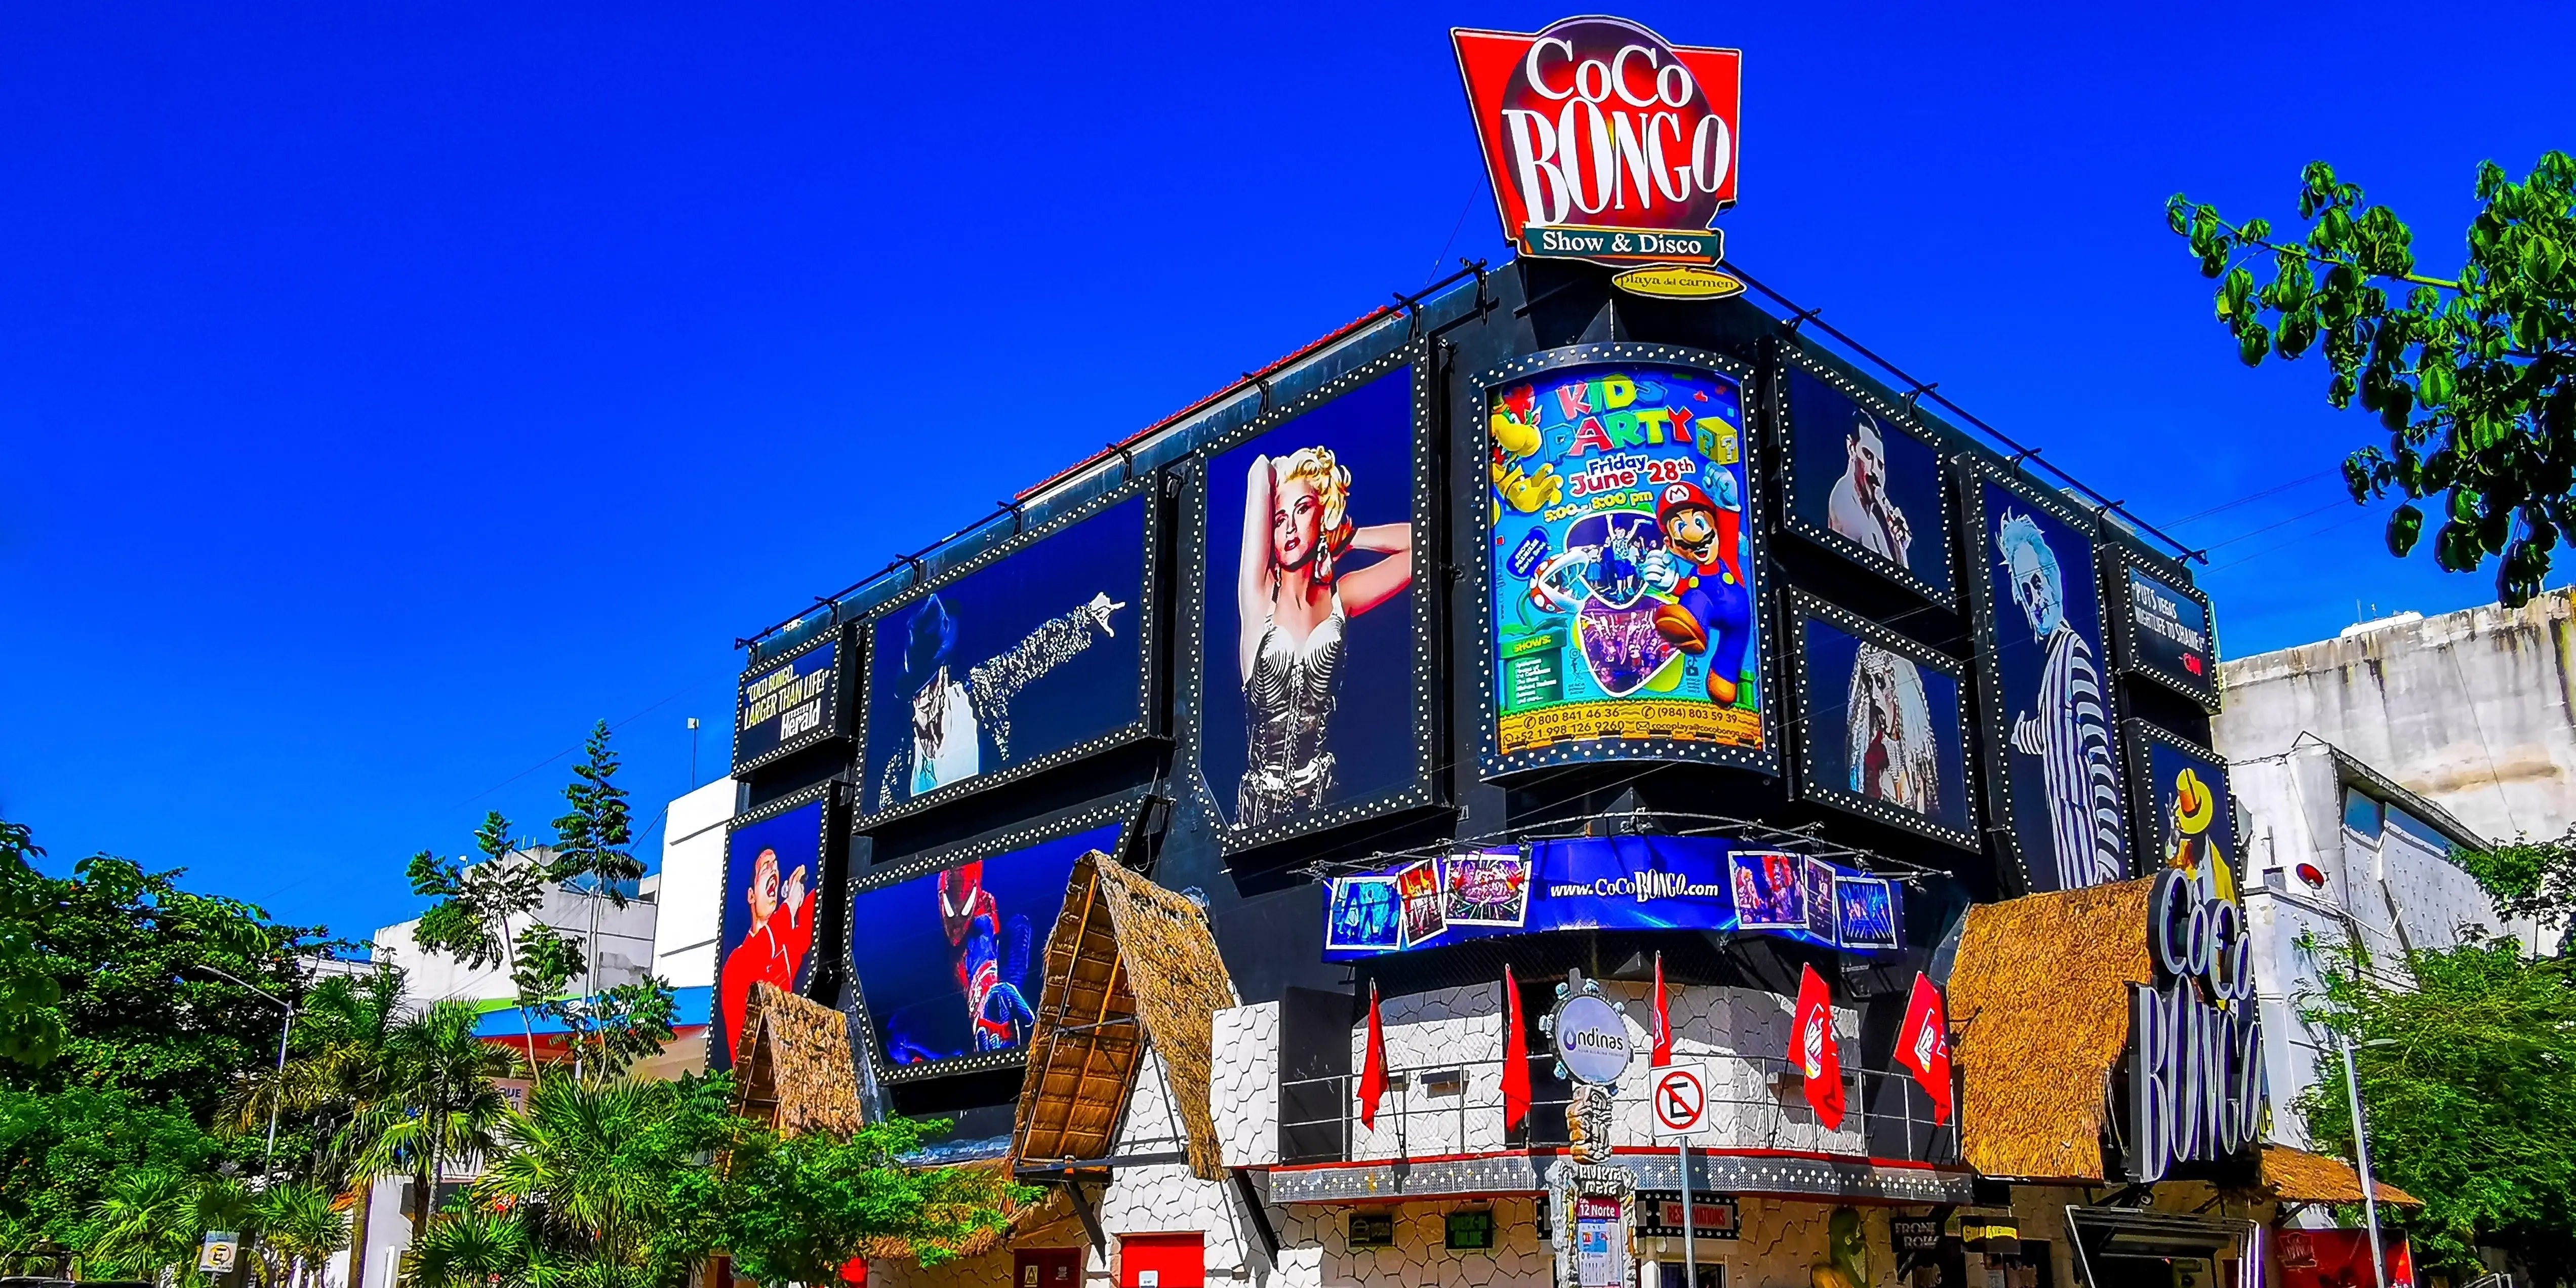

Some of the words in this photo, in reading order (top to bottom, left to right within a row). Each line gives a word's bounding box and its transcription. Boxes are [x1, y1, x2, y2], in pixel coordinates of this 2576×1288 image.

[1501, 95, 1730, 228] BONGO
[1543, 231, 1604, 252] Show
[1611, 233, 1632, 253] &
[1639, 234, 1702, 254] Disco
[1621, 274, 1661, 288] playa
[1679, 278, 1734, 288] carmen
[1557, 373, 1668, 420] KIDS
[1543, 407, 1695, 462] PARTY
[1589, 455, 1646, 475] Friday
[1571, 471, 1635, 495] June
[1647, 459, 1694, 482] 28th
[1544, 503, 1577, 522] 5:00
[1591, 492, 1626, 510] 8:00
[1630, 491, 1653, 506] pm
[744, 693, 778, 731] LARGER
[778, 678, 803, 712] THAN
[1658, 707, 1686, 719] (984)
[1688, 709, 1708, 719] 803
[1711, 711, 1723, 721] 59
[1725, 713, 1738, 723] 39
[780, 698, 821, 742] Herald
[1538, 713, 1559, 726] 800
[1562, 711, 1582, 721] 841
[1586, 708, 1601, 718] 46
[1604, 707, 1620, 717] 36
[1514, 730, 1534, 742] +52
[1537, 729, 1543, 738] 1
[1546, 725, 1567, 736] 998
[1571, 722, 1591, 733] 126
[1594, 720, 1625, 731] 9260
[2139, 972, 2261, 1183] BONGO
[1579, 1204, 1590, 1216] 12
[1591, 1204, 1616, 1217] Norte
[1667, 1204, 1726, 1226] RESVATIONS
[1895, 1222, 1937, 1235] FRONT
[1903, 1235, 1941, 1250] ROW
